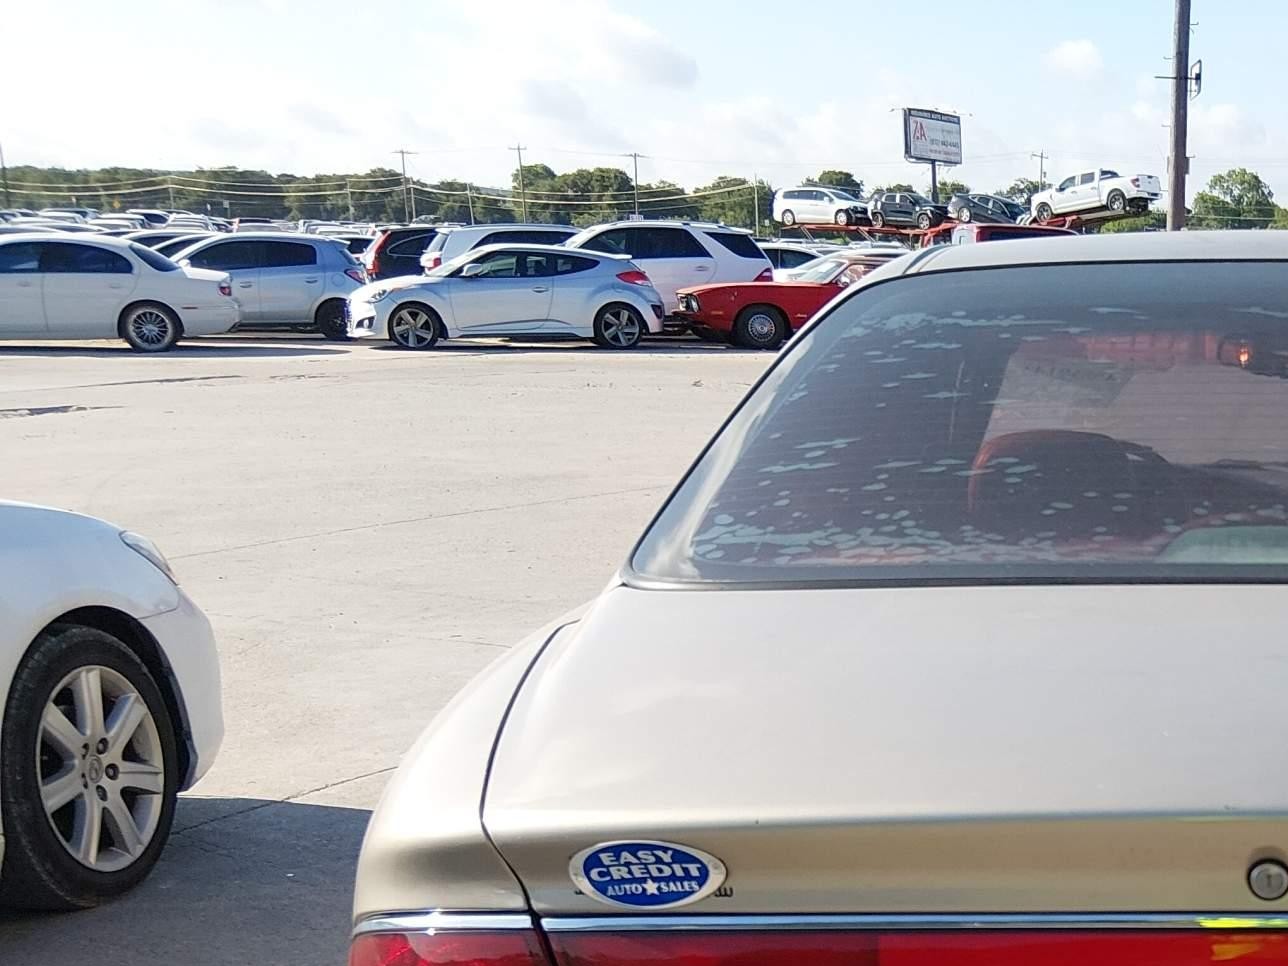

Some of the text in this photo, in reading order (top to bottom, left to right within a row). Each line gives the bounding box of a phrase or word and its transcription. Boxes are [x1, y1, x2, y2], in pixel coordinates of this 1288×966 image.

[598, 850, 674, 866] EASY
[590, 863, 702, 881] CREDIT
[606, 883, 643, 897] AUTO
[660, 880, 700, 893] SALES
